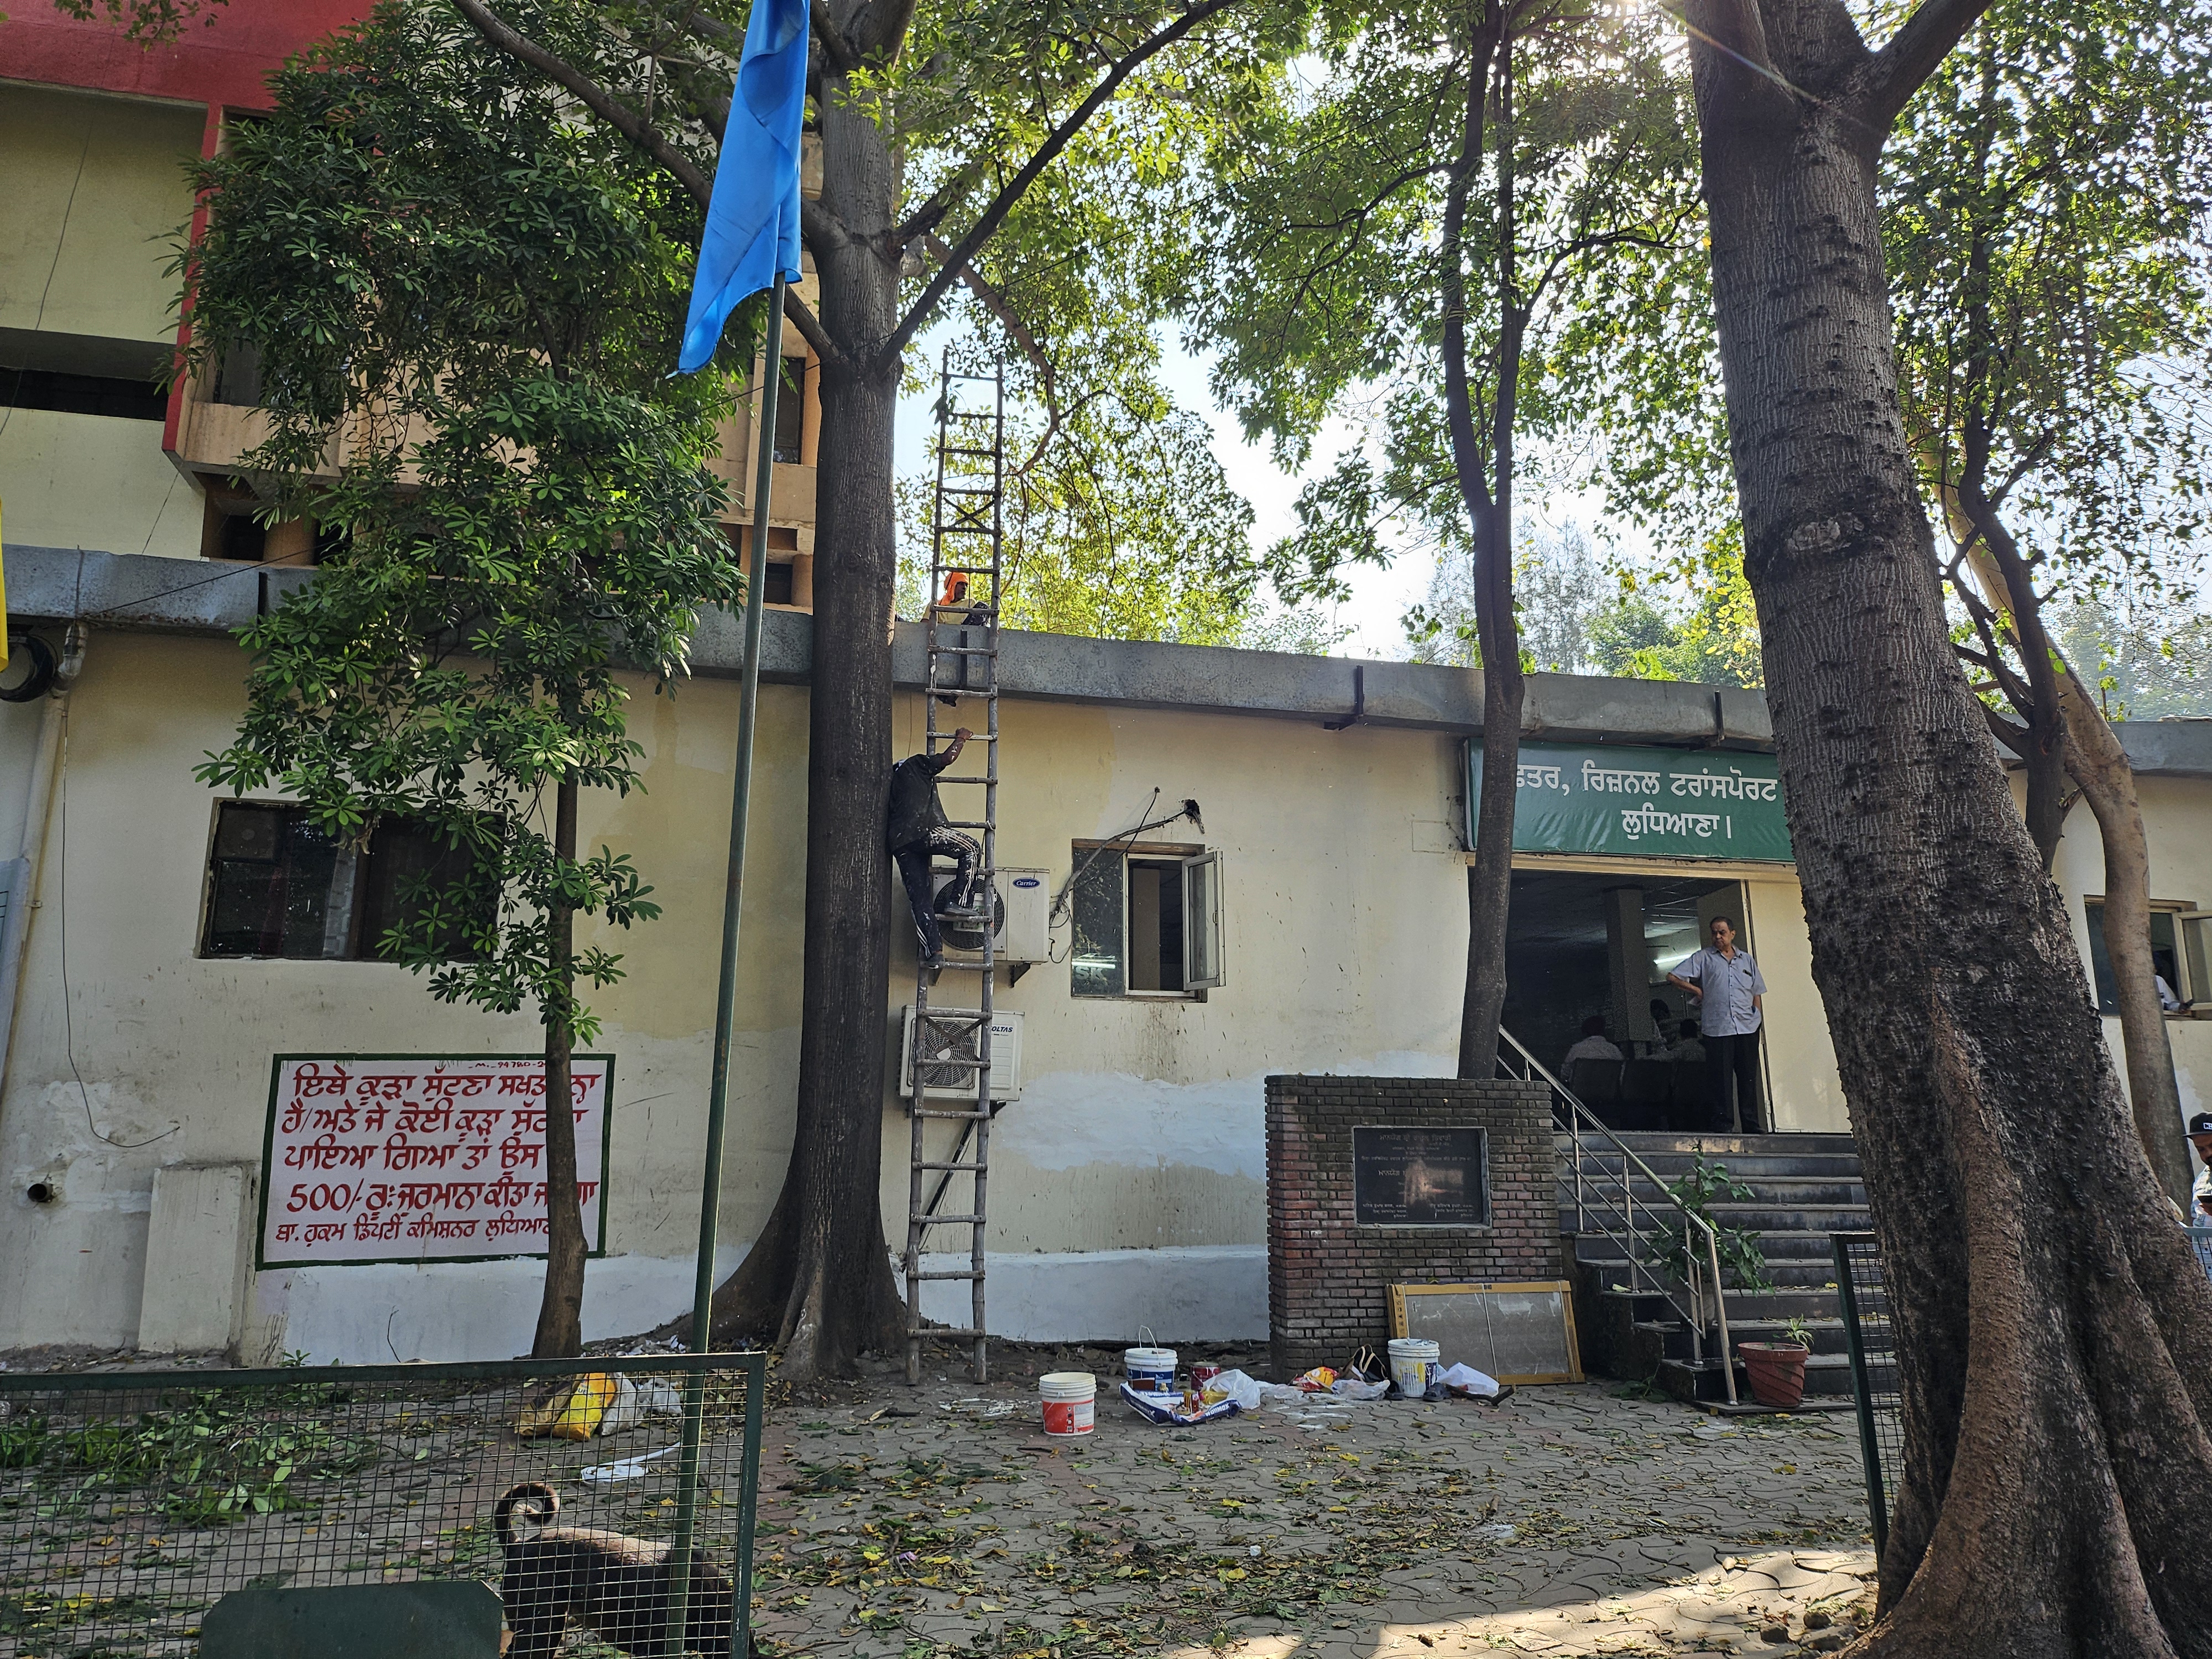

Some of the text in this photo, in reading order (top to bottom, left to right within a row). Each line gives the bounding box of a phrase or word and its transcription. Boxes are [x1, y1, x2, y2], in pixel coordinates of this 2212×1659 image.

[1581, 759, 1660, 794] ਰਿਜ਼ਨਲ
[1670, 766, 1777, 801] ਟਰਾਂਸਪੋਰਟ
[365, 1100, 391, 1133] ਜੇ
[395, 1097, 454, 1133] ਕੋਈ
[383, 1133, 461, 1170] ਗਿਆ
[286, 1178, 362, 1213] 500/-
[304, 1223, 347, 1247] ਹੁਕਮ
